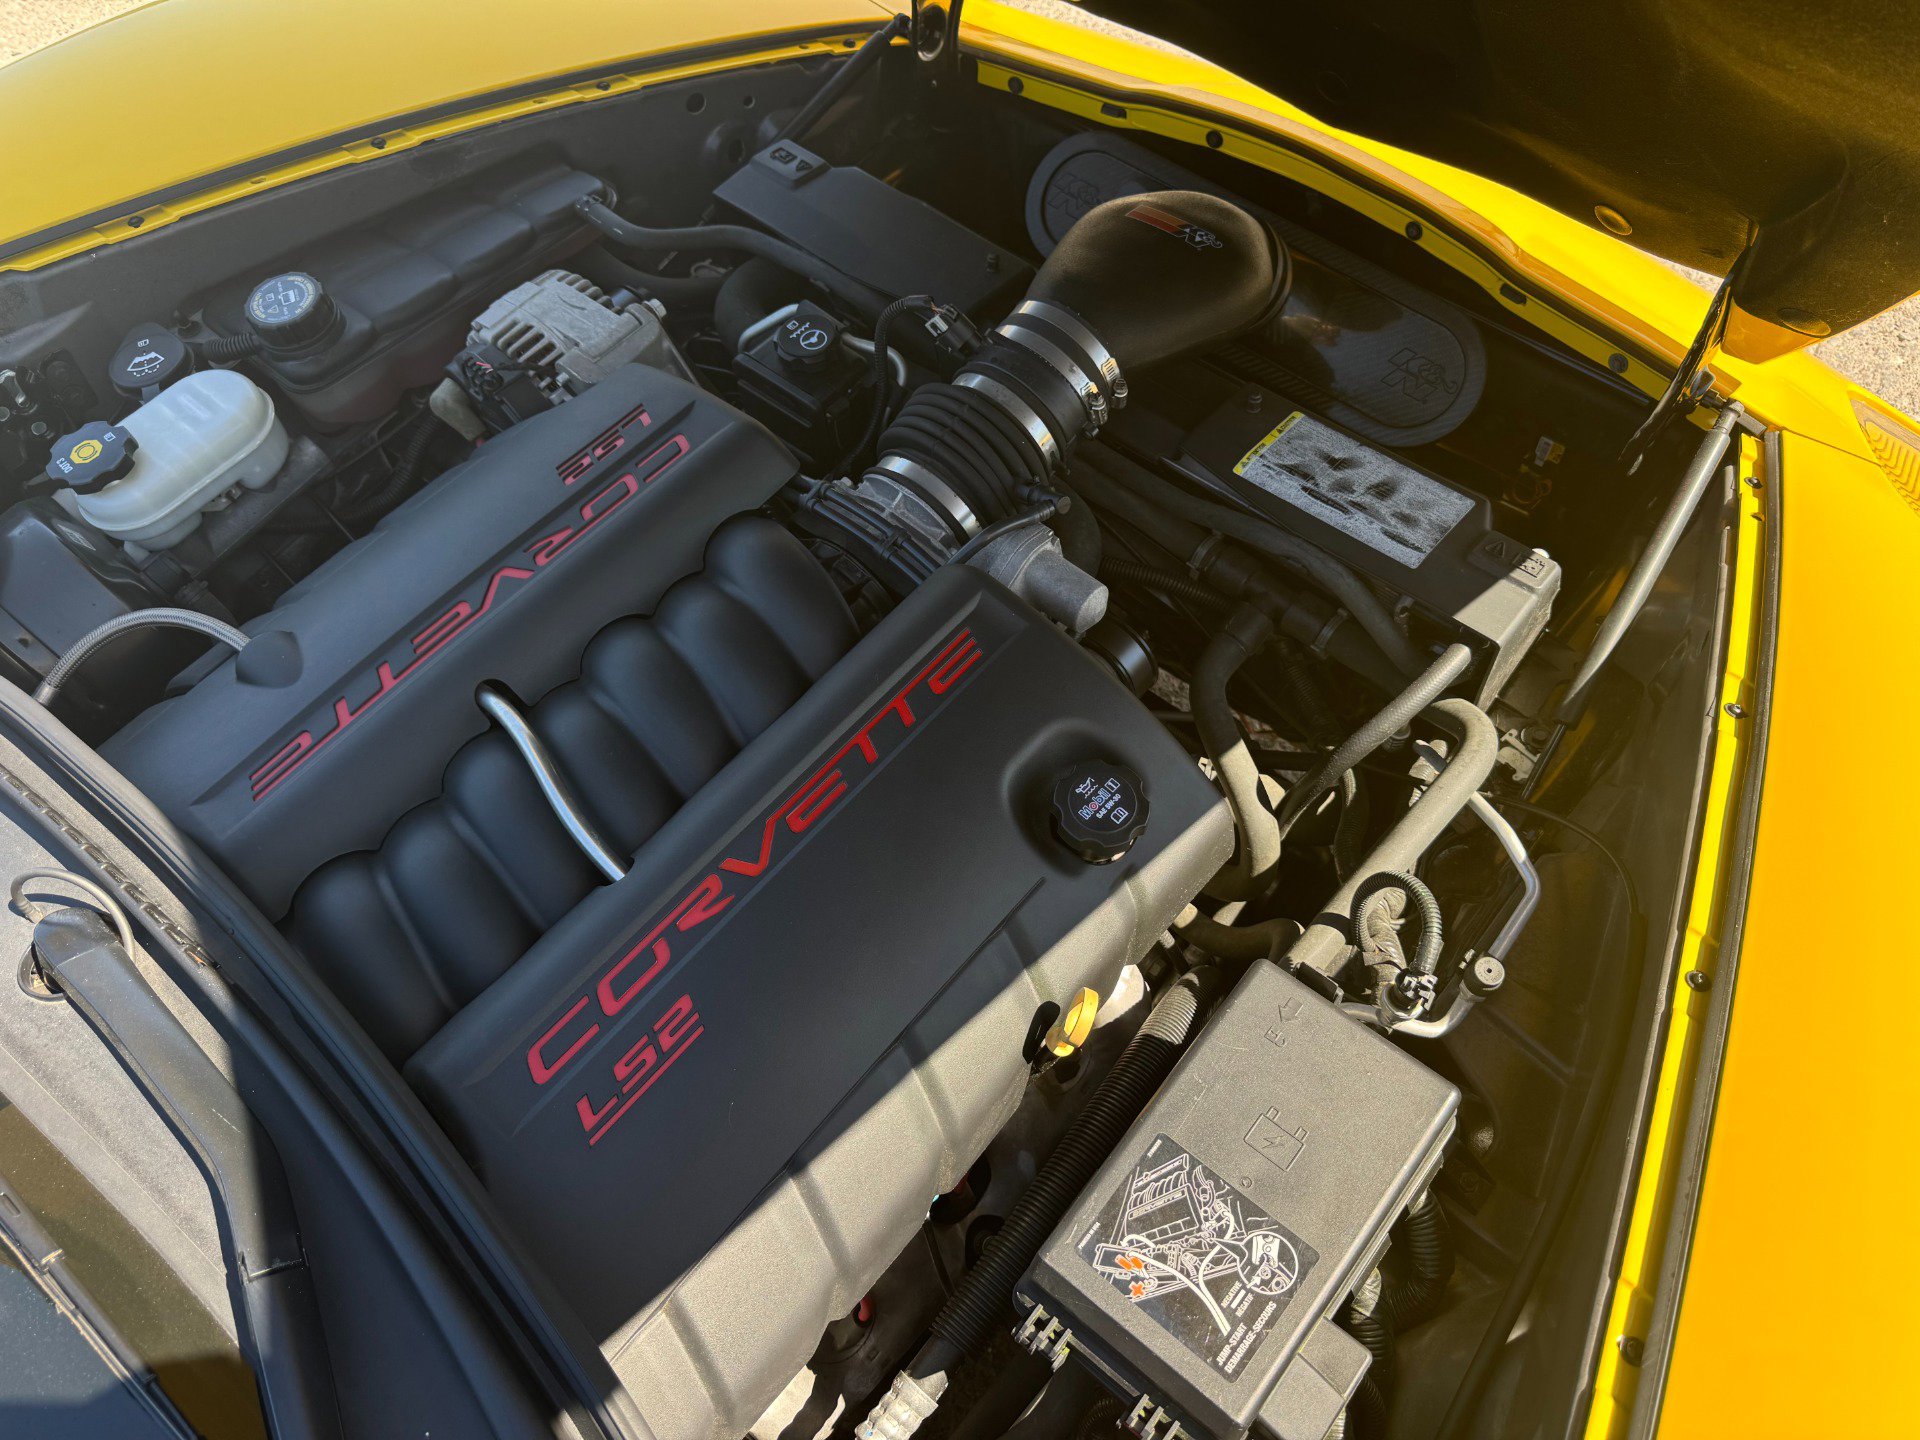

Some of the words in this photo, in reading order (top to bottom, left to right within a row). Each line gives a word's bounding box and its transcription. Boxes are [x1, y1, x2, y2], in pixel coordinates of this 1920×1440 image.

[558, 406, 652, 486] LS2
[249, 433, 691, 802] CORVETTE
[1077, 787, 1111, 820] Mobil
[1096, 808, 1108, 819] SAE
[1104, 793, 1121, 810] 5W-30
[527, 626, 983, 1085] CORVETTE
[576, 993, 702, 1136] LS2
[1221, 1280, 1242, 1308] NEGATIVE
[1216, 1322, 1247, 1366] JUMP-START
